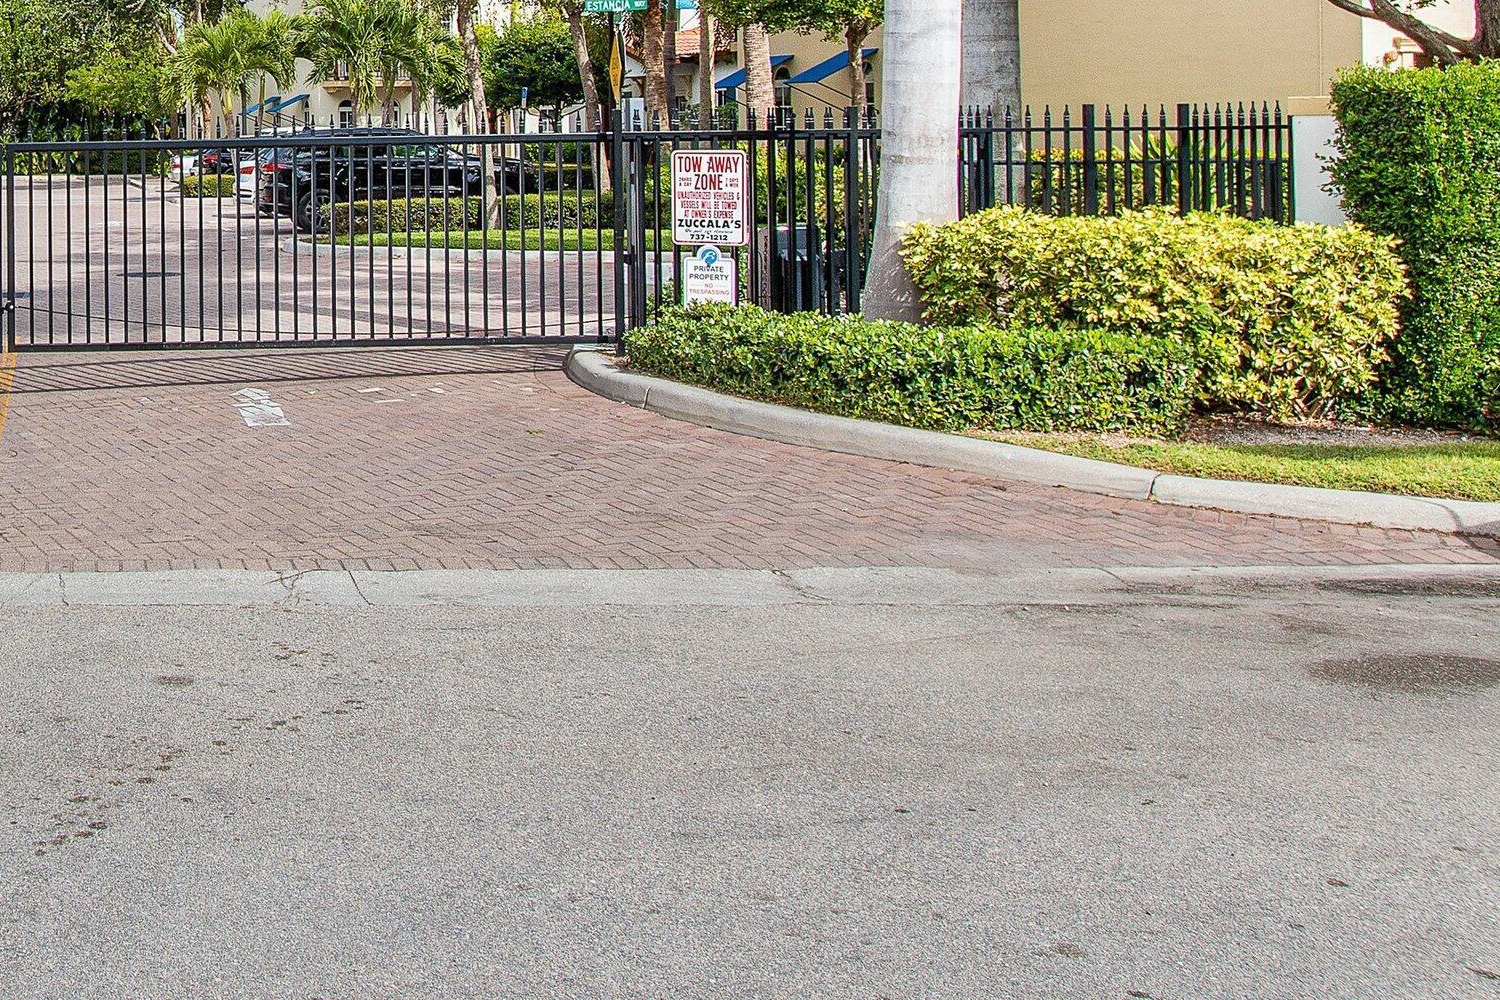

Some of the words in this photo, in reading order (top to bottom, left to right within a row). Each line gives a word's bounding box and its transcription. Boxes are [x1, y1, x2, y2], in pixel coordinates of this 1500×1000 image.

[587, 0, 630, 10] ESTANCIA
[677, 156, 702, 172] TOW
[707, 156, 740, 173] AWAY
[694, 173, 723, 191] ZONE
[677, 191, 711, 199] UNAUTHORIZED
[713, 192, 735, 200] VEHICLES
[681, 201, 699, 209] VESSELS
[700, 201, 711, 209] WILL
[713, 201, 720, 209] BE
[721, 201, 737, 209] TOWED
[684, 209, 690, 218] AT
[713, 211, 734, 219] EXPENSE
[677, 219, 741, 229] ZUCCALA'S
